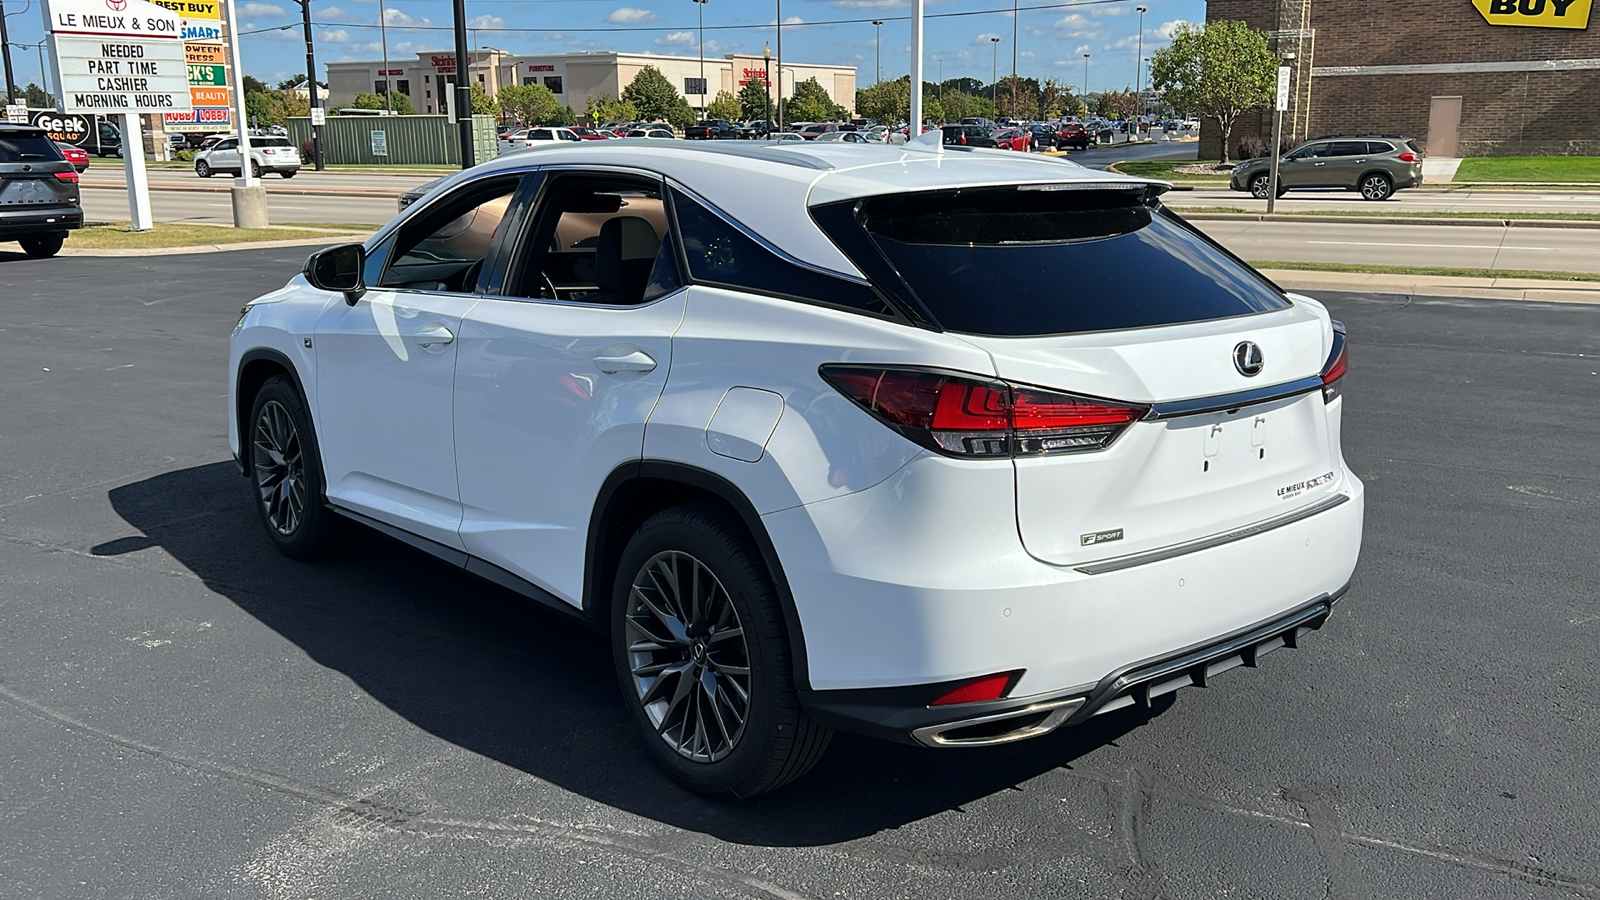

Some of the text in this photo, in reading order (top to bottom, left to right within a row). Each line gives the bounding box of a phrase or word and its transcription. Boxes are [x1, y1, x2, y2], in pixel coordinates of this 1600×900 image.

[188, 3, 213, 13] BUY
[1490, 0, 1576, 16] BUY
[59, 13, 175, 32] LE MIEUX & SON
[101, 43, 144, 58] NEEDED
[88, 60, 158, 75] PART TIME
[97, 77, 148, 91] CASHIER
[75, 93, 173, 108] MORNING HOURS
[195, 91, 226, 100] BEAUTY
[199, 110, 227, 120] LOBBY
[38, 116, 85, 132] Geek
[1277, 481, 1305, 496] LE MIEUX
[1096, 531, 1121, 541] SPORT
